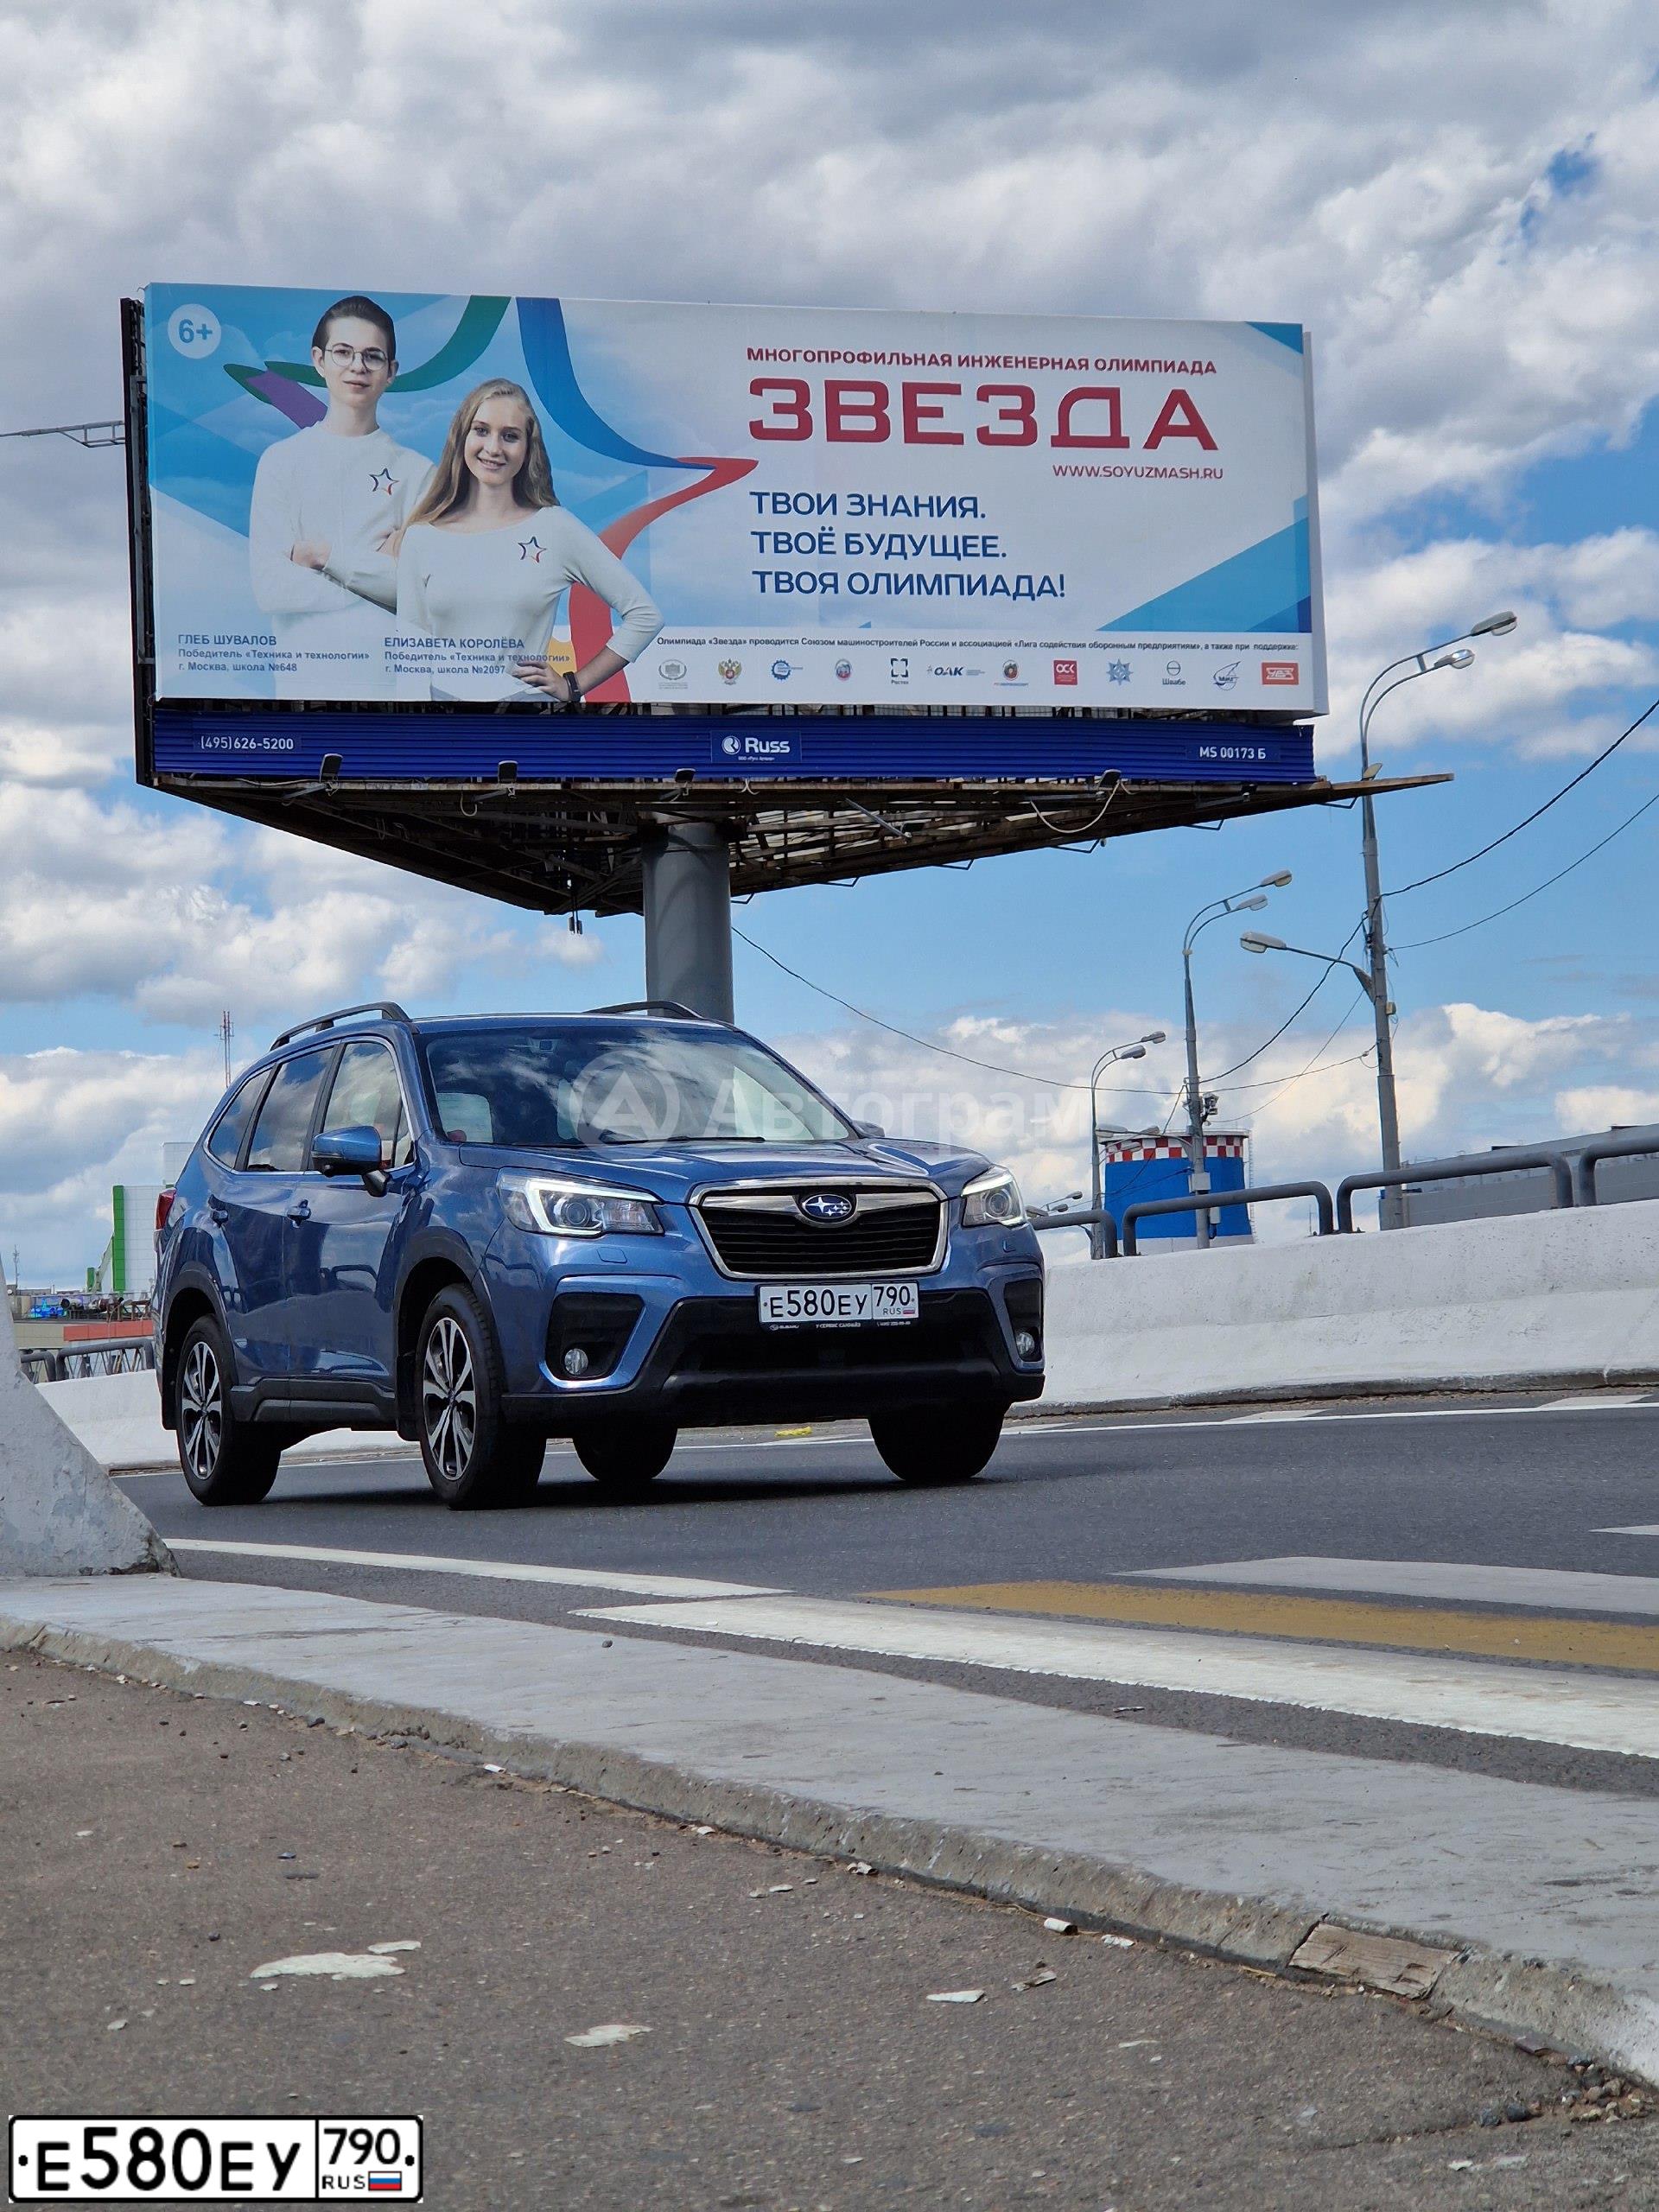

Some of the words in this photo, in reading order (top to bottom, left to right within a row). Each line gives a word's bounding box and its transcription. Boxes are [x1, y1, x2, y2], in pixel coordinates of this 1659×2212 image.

[178, 319, 213, 344] 6+
[747, 347, 952, 367] МНОГОПРОФИЛЬНАЯ
[957, 354, 1090, 371] ИНЖЕНЕРНАЯ
[1094, 358, 1217, 376] ОЛИМПИАДА
[748, 377, 1219, 450] ЗВЕЗДА
[1052, 464, 1224, 480] WWW.SOYUZMASH.RU
[749, 491, 838, 516] ТВОИ
[846, 493, 987, 518] ЗНАНИЯ.
[750, 525, 837, 555] ТВОЁ
[844, 532, 1007, 562] БУДУЩЕЕ.
[752, 570, 839, 594] ТВОЯ
[847, 572, 1066, 601] ОЛИМПИАДА!
[178, 634, 210, 645] ГЛЕБ
[213, 635, 277, 646] ШУВАЛОВ
[384, 638, 457, 648] ЕЛИЗАВЕТА
[460, 636, 525, 649] КОРОЛЁВА
[656, 637, 707, 646] Олимпиада
[709, 638, 747, 646] «Звезда»
[748, 638, 800, 647] проводится
[801, 638, 836, 646] Союзом
[837, 639, 918, 647] машиностроителей
[919, 639, 950, 648] России
[958, 640, 1013, 649] ассоциацией
[1014, 639, 1038, 649] «Лига
[1039, 640, 1087, 649] содействия
[1088, 641, 1136, 651] оборонным
[1137, 641, 1203, 652] предприятиям»,
[178, 649, 243, 659] Победитель
[245, 650, 294, 659] «Техника
[304, 652, 370, 660] технологии»
[384, 652, 447, 662] Победитель
[449, 652, 497, 662] «Техника
[507, 654, 570, 663] технологии»
[188, 662, 230, 672] Москва,
[232, 664, 266, 672] школа
[268, 663, 298, 672] №648
[393, 664, 435, 675] Москва,
[437, 665, 470, 674] школа
[472, 665, 506, 675] №2097
[200, 735, 295, 750] (495)626-5200
[744, 737, 791, 753] Russ
[1219, 747, 1255, 760] 00173
[1256, 747, 1267, 760] Б
[873, 1285, 912, 1307] 790
[882, 1307, 902, 1316] RUS
